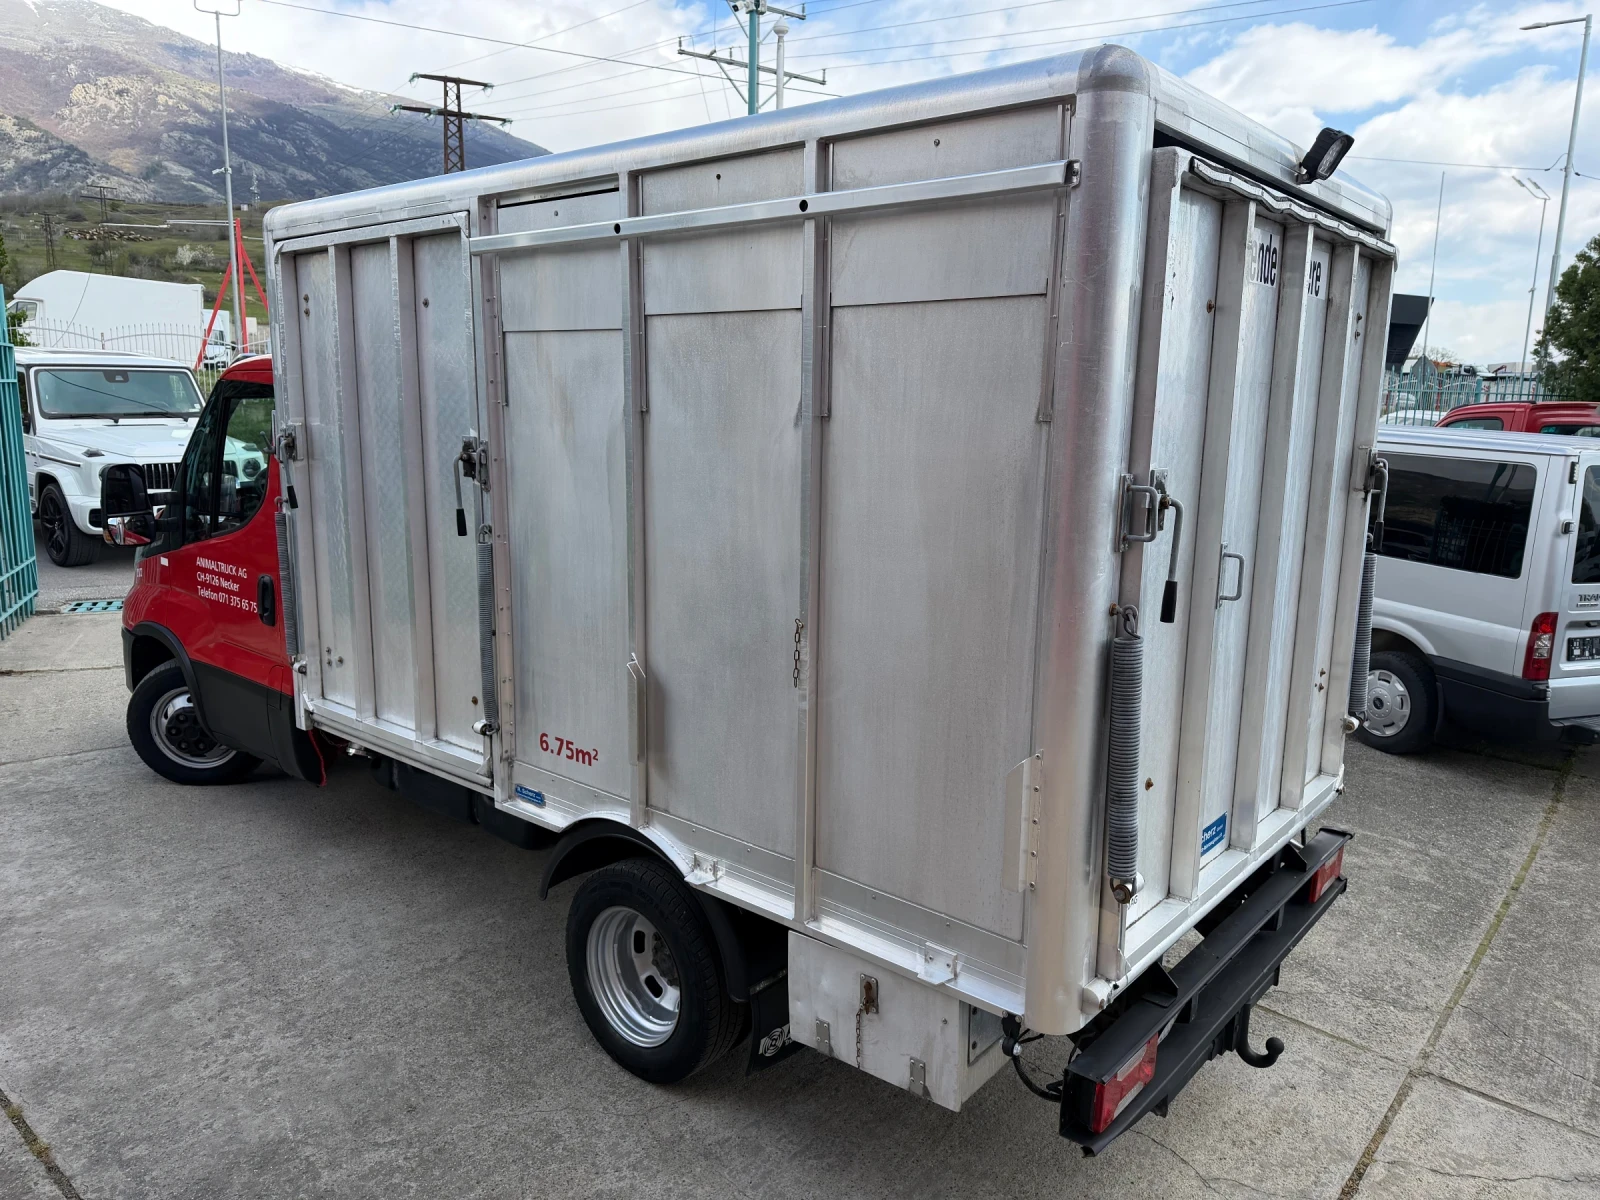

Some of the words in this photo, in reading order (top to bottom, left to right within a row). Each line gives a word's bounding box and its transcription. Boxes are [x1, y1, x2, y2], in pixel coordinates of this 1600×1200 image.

[196, 556, 237, 576] ANIMALTRUCK
[238, 567, 247, 579] AG
[196, 572, 219, 586] CH-9126
[220, 577, 240, 592] Necker
[197, 586, 218, 600] Telefon
[218, 592, 229, 604] 071
[230, 595, 240, 608] 375
[241, 599, 249, 611] 65
[250, 601, 258, 613] 75
[539, 732, 599, 767] 6.75m²
